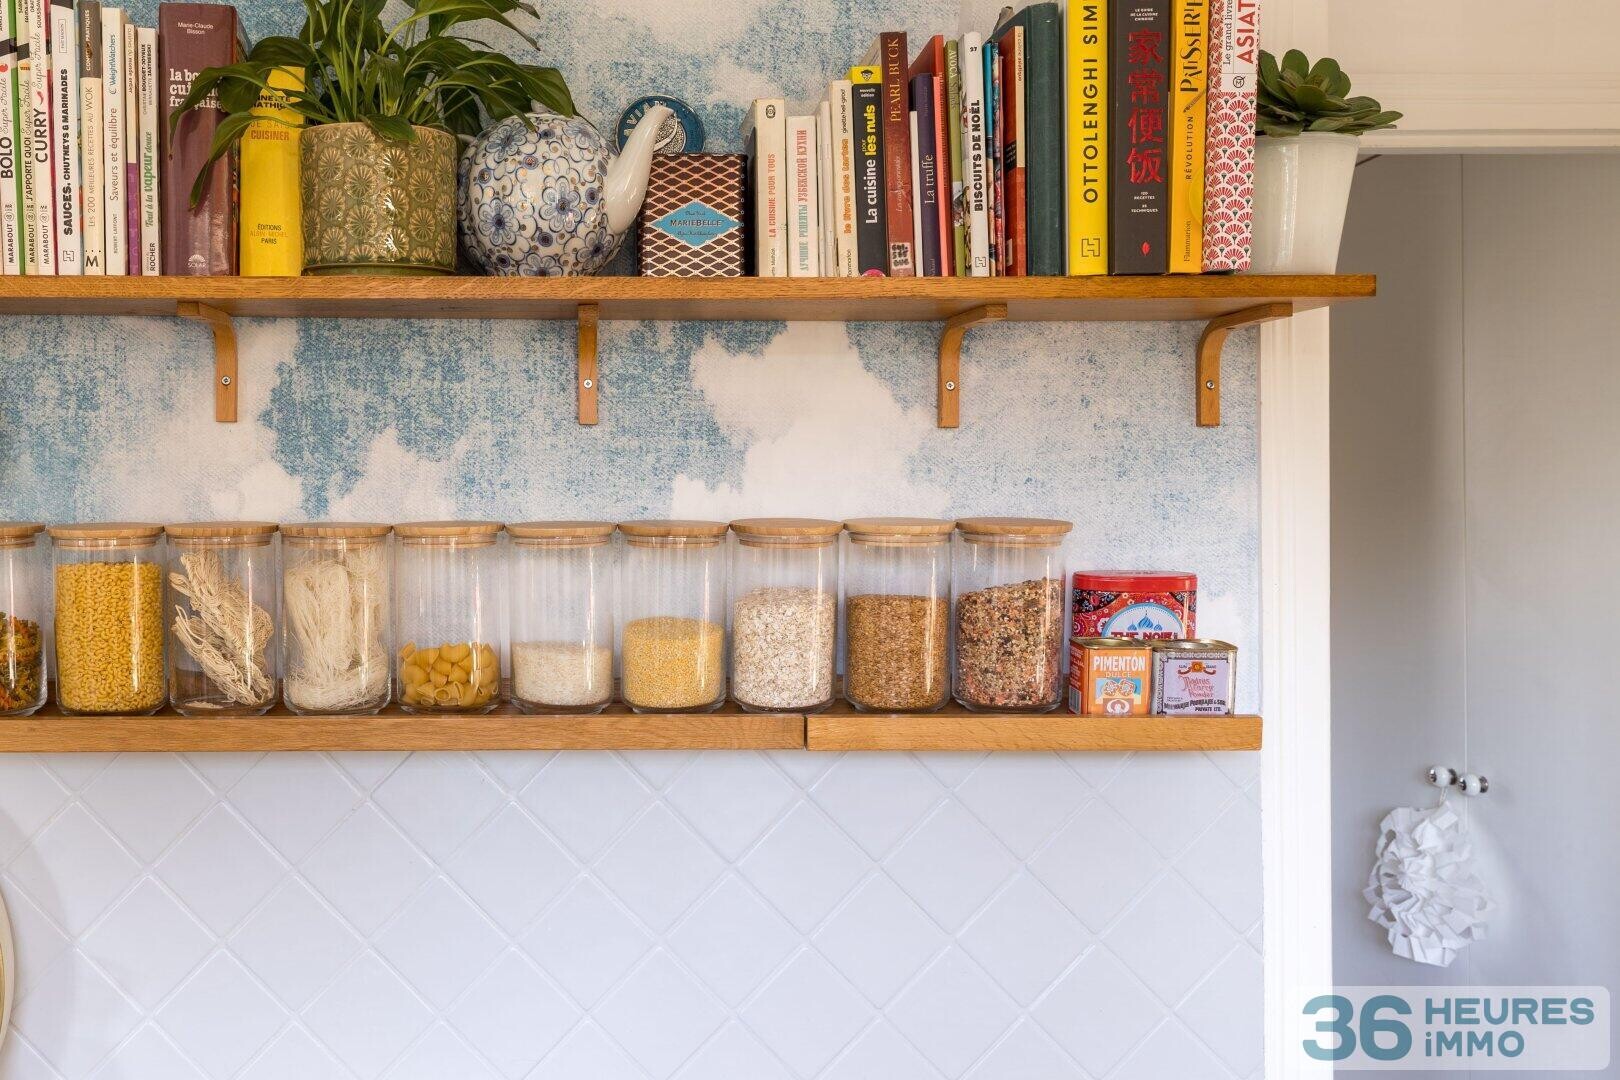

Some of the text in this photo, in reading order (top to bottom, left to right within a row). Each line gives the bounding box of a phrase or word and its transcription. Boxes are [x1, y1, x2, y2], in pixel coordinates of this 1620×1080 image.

[1223, 0, 1233, 65] Le grand livre
[108, 34, 118, 86] WeightWatchers
[170, 68, 182, 81] la
[887, 37, 902, 121] PEARL BUCK
[948, 49, 958, 78] AVOCA
[60, 69, 69, 123] MARINADES
[84, 87, 94, 111] WOK
[34, 108, 48, 163] CURRY
[251, 130, 289, 140] CUISINER
[864, 104, 876, 133] nuls
[1083, 58, 1099, 203] OTTOLENGHI
[0, 136, 13, 179] BOLO
[24, 137, 32, 158] QUOI
[62, 132, 71, 180] CHUTNEYS
[108, 108, 121, 201] Saveurs et équilibre
[144, 131, 153, 153] douce
[796, 130, 807, 155] КУХНИ
[864, 135, 877, 156] les
[968, 99, 984, 212] BISCUITS DE NOËL
[1186, 115, 1194, 180] RÉVOLUTION
[25, 161, 33, 201] J'APPORTE
[143, 152, 156, 192] vapeur
[864, 159, 877, 206] cuisine
[921, 154, 935, 204] La truffe
[145, 194, 153, 203] la
[767, 153, 777, 238] LA CUISINE POUR TOUS
[145, 211, 153, 228] Tout
[670, 219, 722, 227] MARIEBELLE
[865, 208, 878, 224] La
[7, 224, 15, 264] MARABOUT
[42, 225, 50, 264] MARABOUT
[1183, 220, 1191, 262] Flammarion
